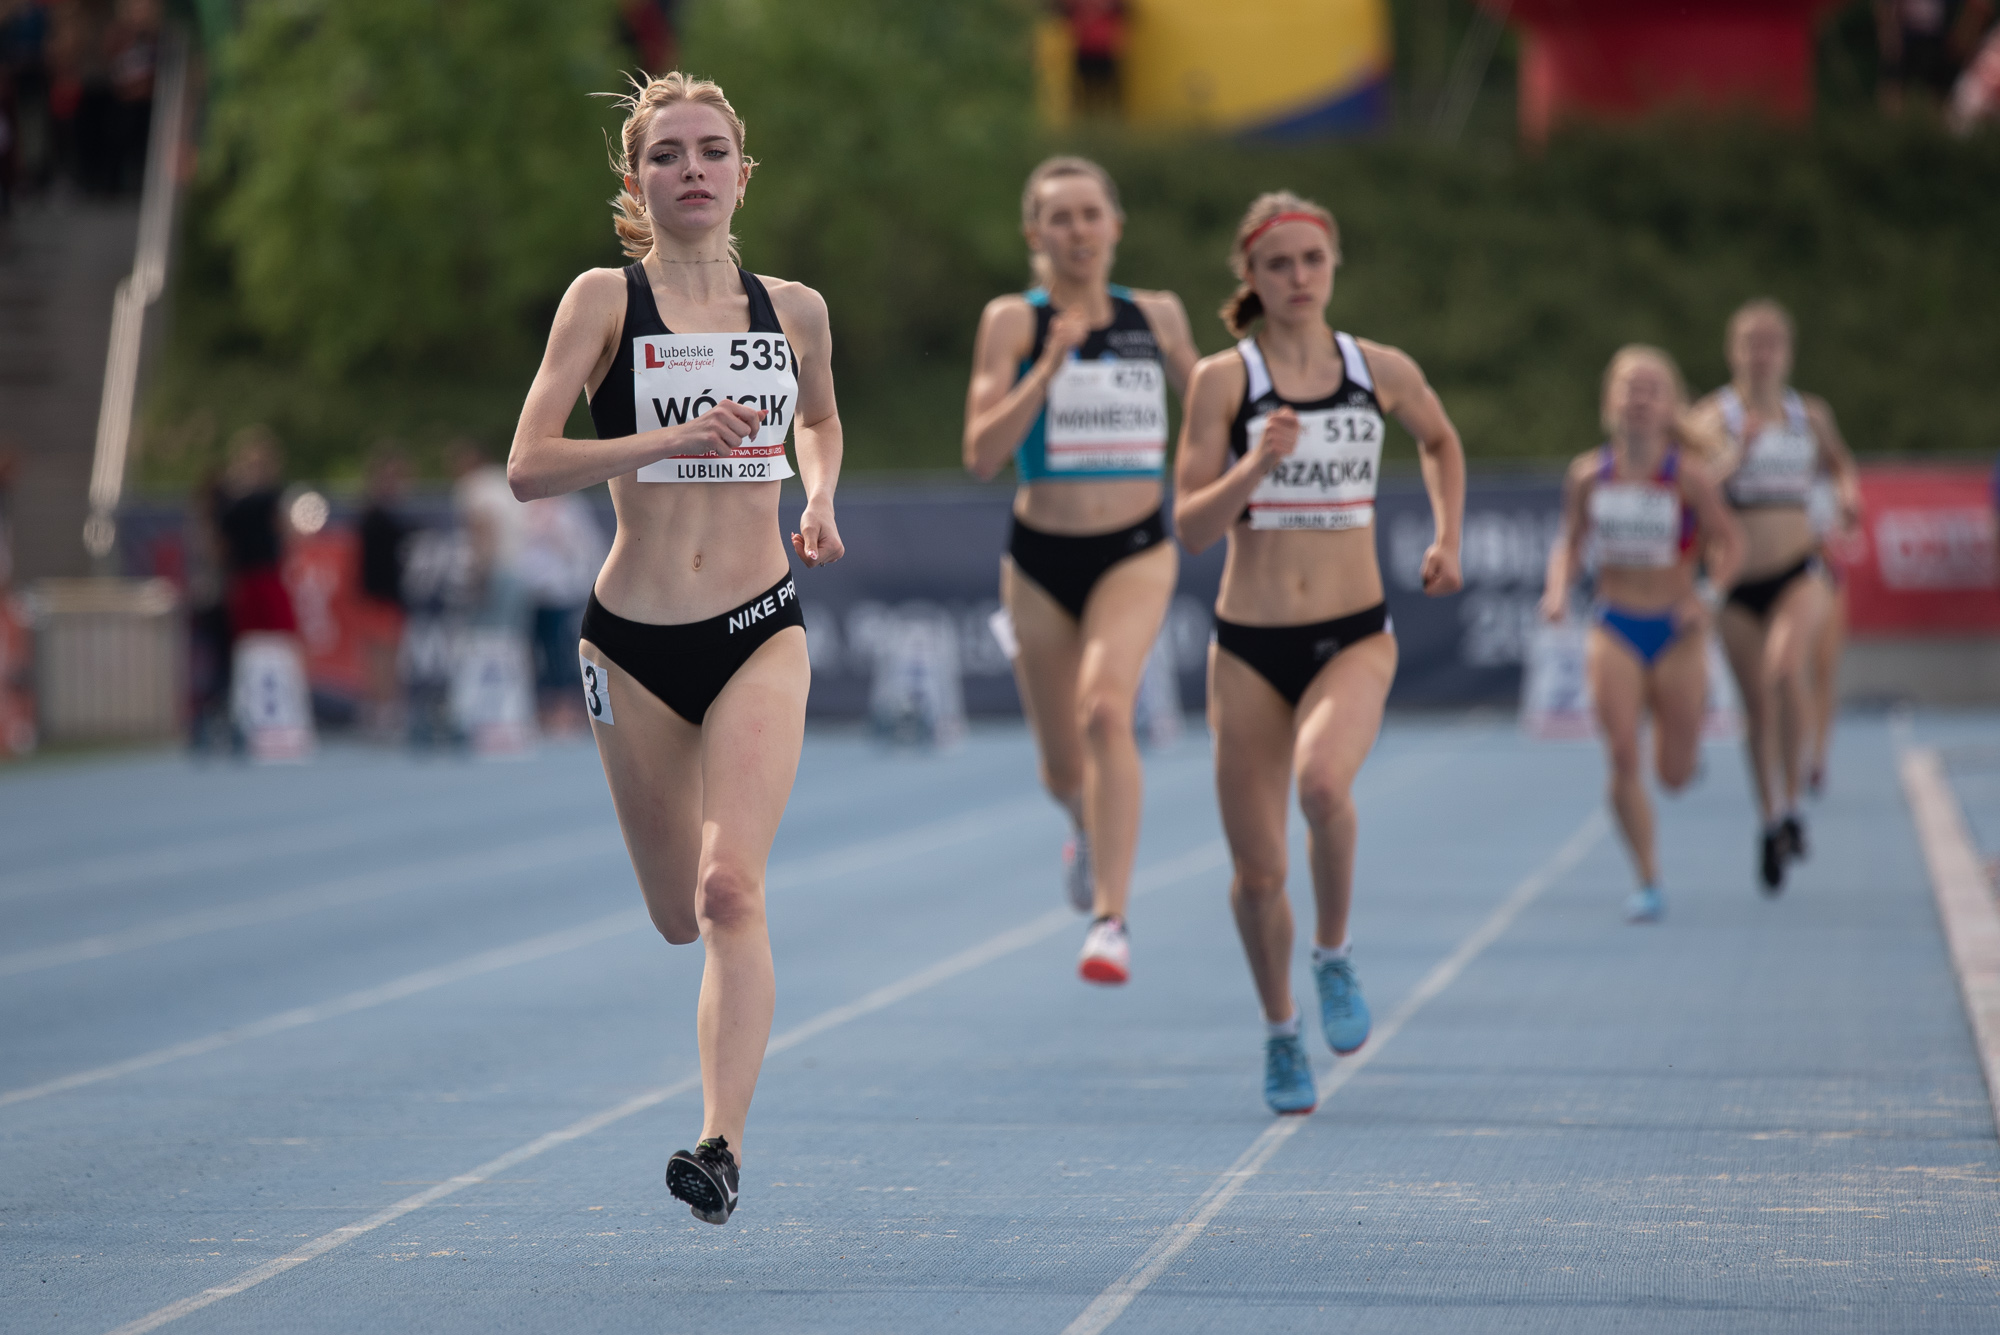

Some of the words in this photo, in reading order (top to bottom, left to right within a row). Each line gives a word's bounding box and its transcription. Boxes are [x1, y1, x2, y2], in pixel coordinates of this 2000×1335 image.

[659, 345, 714, 358] lubelskie
[667, 358, 694, 372] Smakuj
[729, 338, 787, 371] 535
[652, 388, 788, 427] WÓIK
[1324, 418, 1376, 443] 512
[677, 464, 733, 479] LUBLIN
[738, 463, 771, 478] 2021
[729, 595, 777, 634] NIKE
[777, 576, 796, 607] PR
[585, 665, 603, 717] 3
